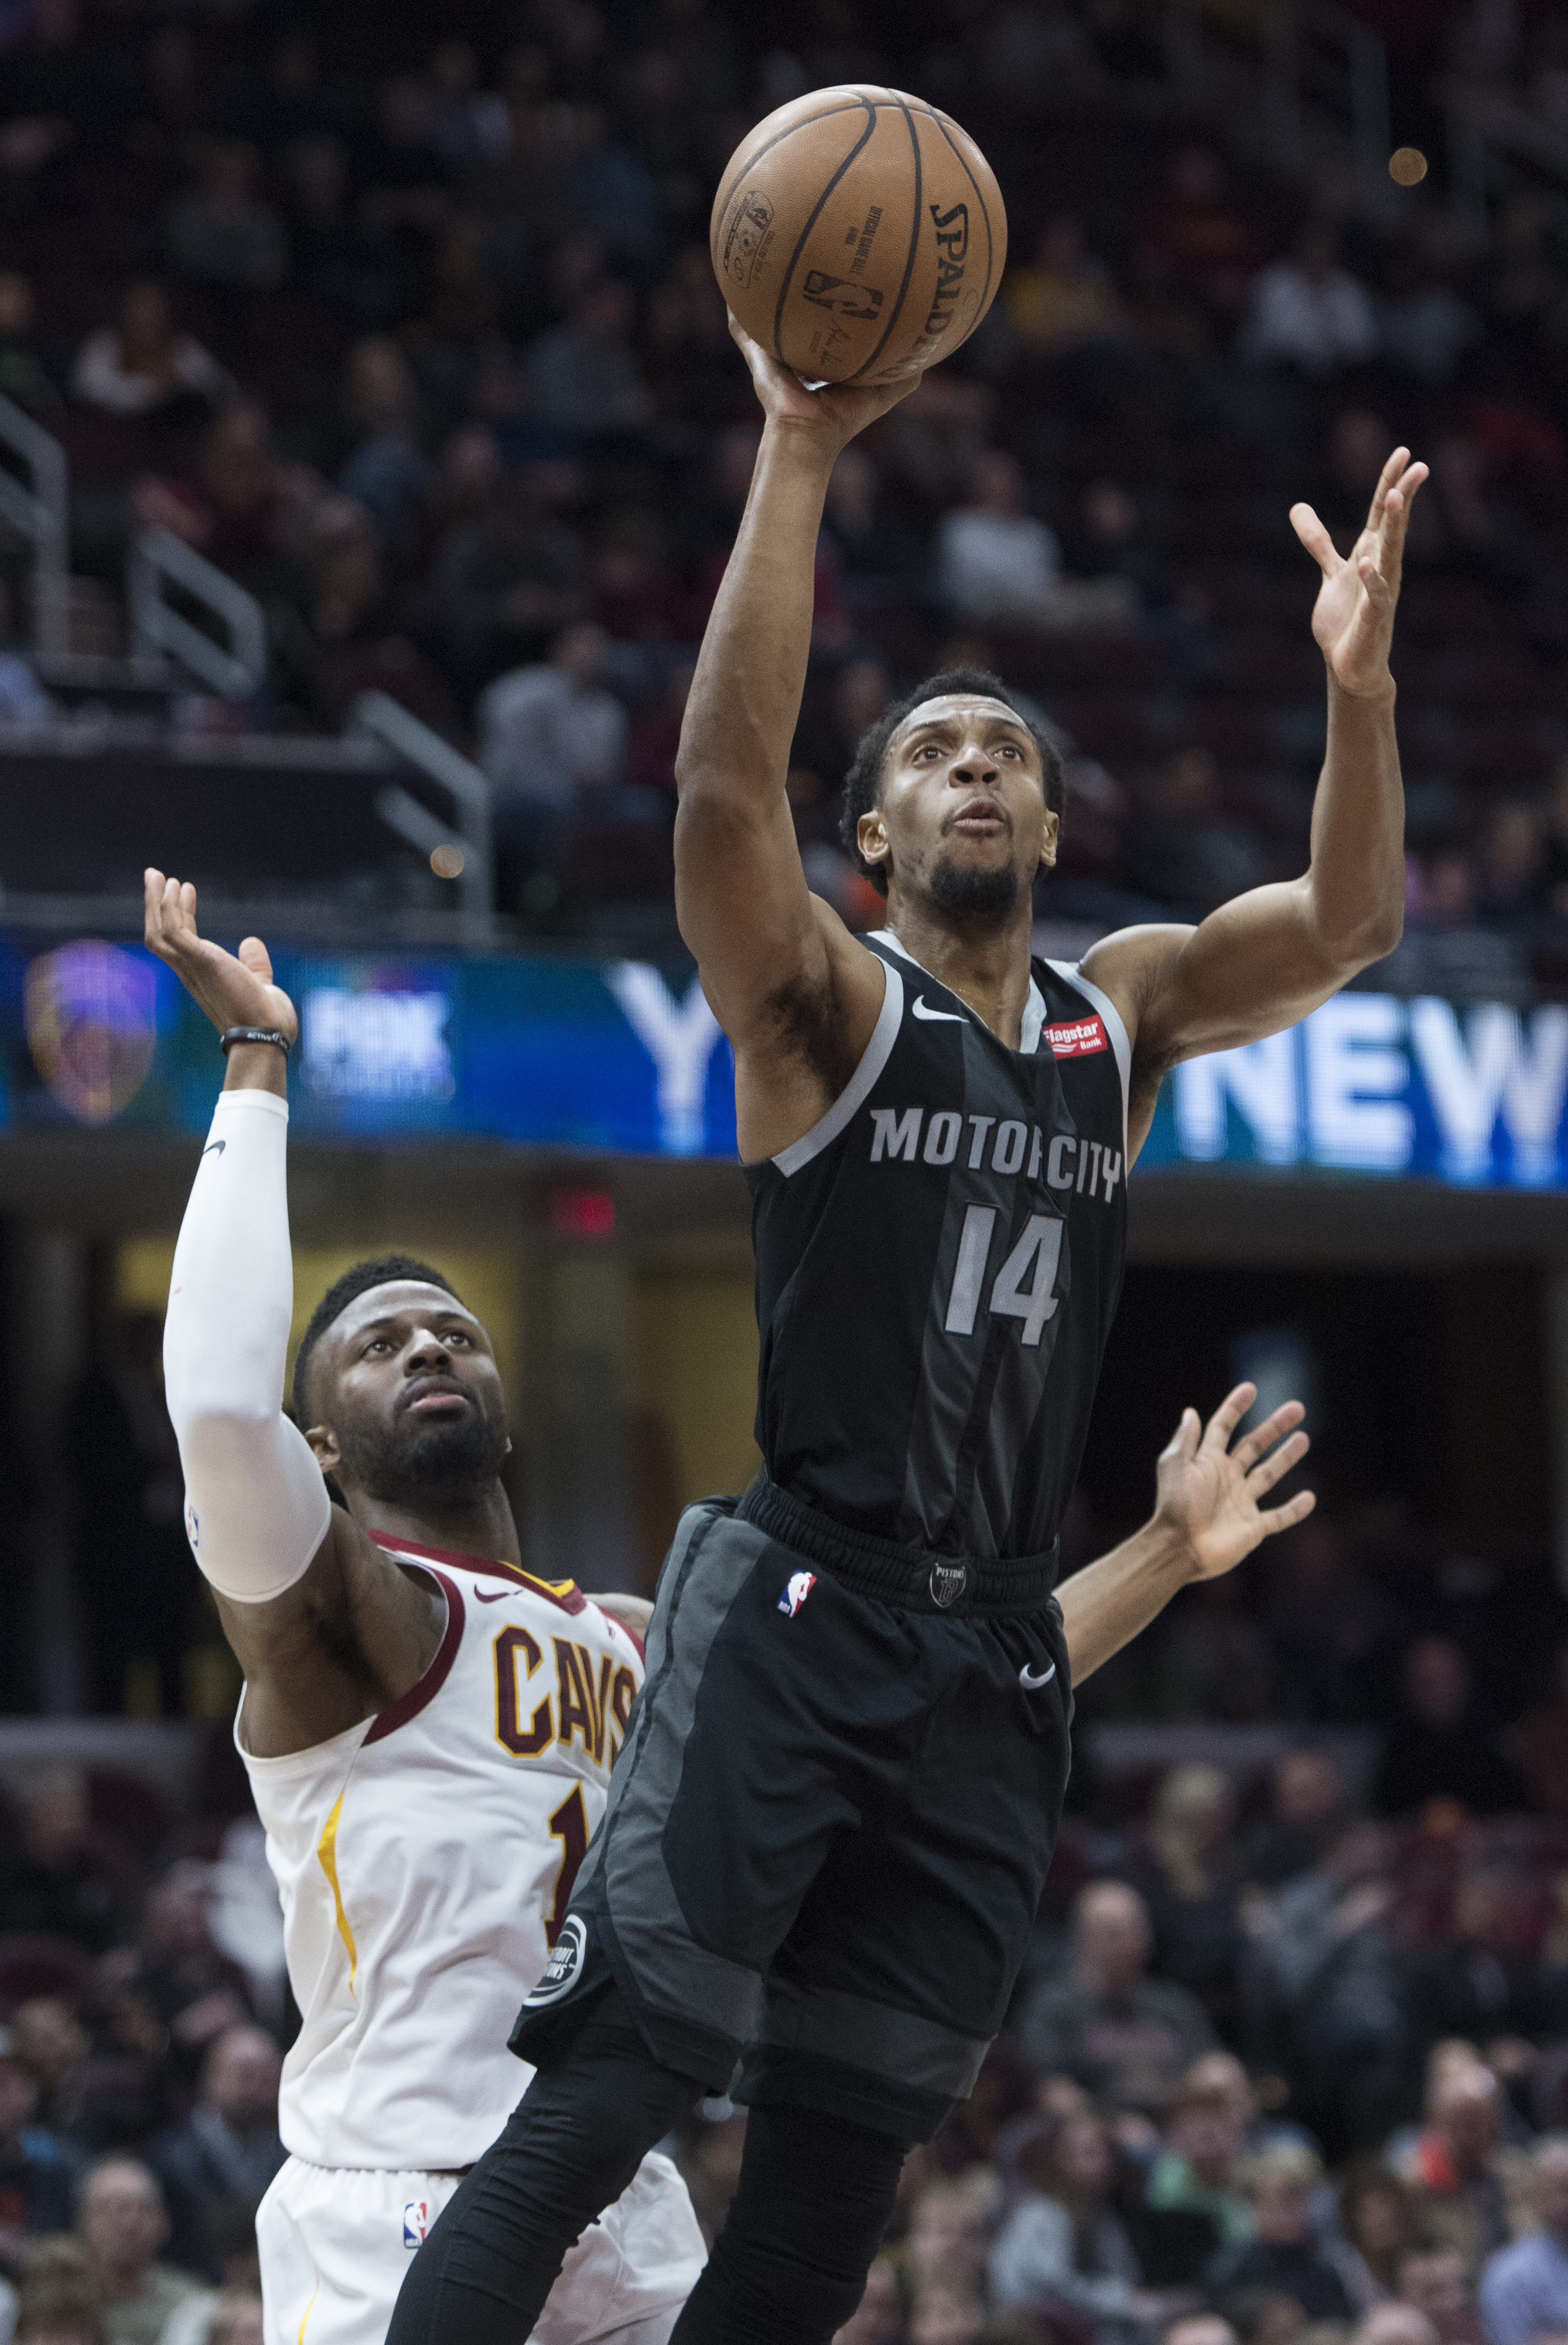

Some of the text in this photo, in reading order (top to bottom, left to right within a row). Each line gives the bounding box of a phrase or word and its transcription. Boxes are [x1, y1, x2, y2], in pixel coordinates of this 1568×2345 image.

[862, 206, 882, 237] OFFICIAL
[856, 237, 872, 258] GAME
[1080, 1037, 1102, 1050] Bank
[1175, 991, 1568, 1190] NEW
[1047, 1134, 1122, 1204] CITY
[945, 1204, 1063, 1346] 14
[936, 1566, 965, 1579] PISTONS
[492, 1624, 638, 1773] CAVS
